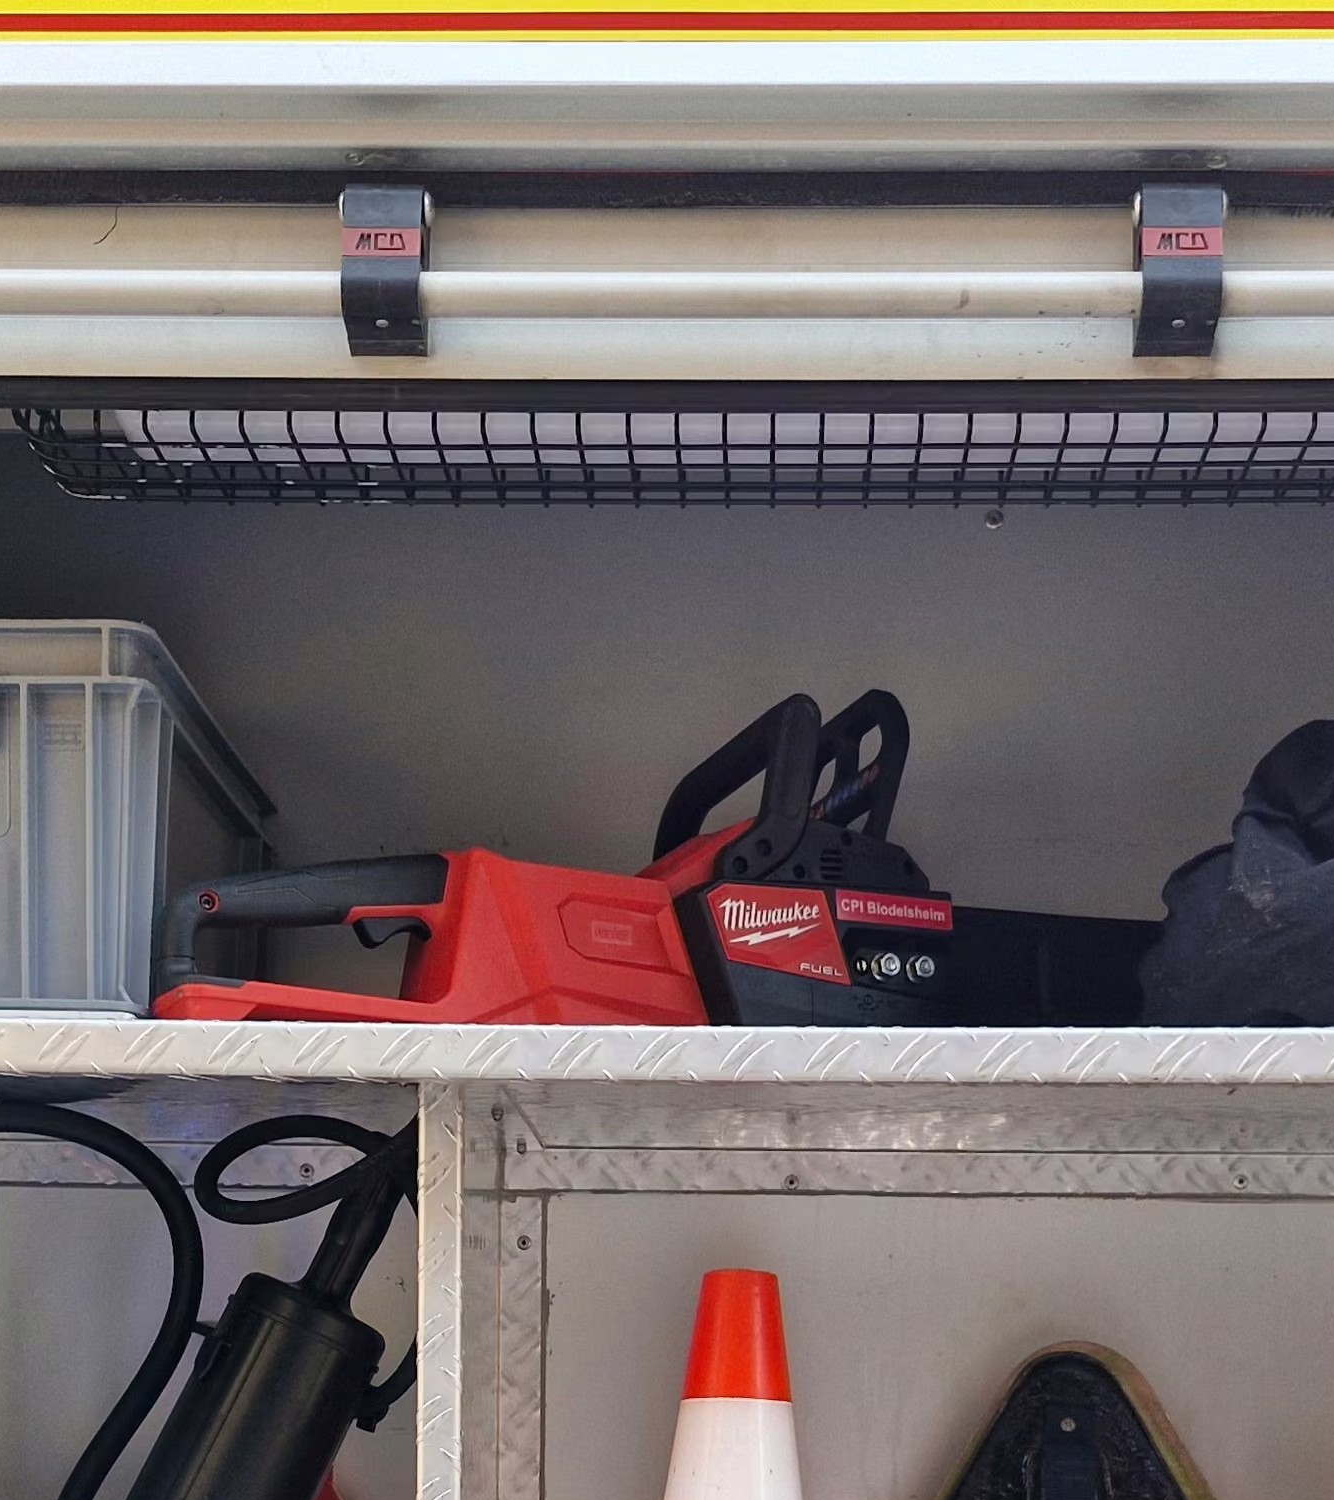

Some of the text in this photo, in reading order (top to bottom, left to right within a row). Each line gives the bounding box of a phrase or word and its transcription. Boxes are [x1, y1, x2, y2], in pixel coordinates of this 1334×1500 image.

[840, 899, 864, 914] CPI
[719, 898, 820, 931] Milwaukee
[799, 962, 843, 976] FUEL
